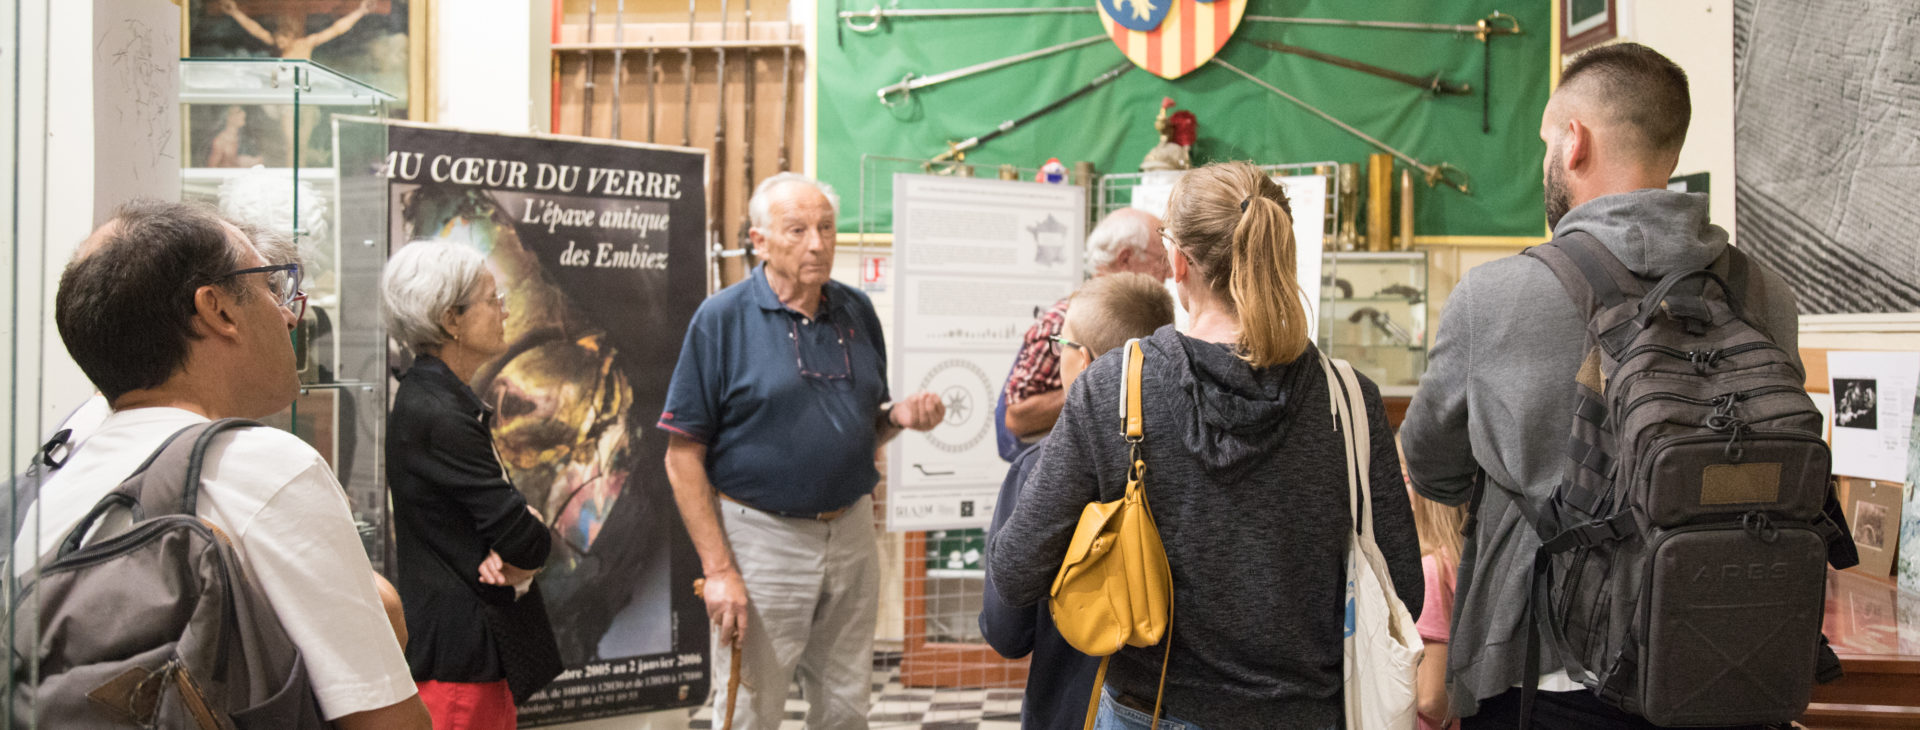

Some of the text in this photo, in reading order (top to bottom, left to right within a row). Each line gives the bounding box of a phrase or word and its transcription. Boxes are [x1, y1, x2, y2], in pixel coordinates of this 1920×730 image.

[377, 151, 681, 199] AU CŒUR DU VERRE
[522, 199, 670, 238] L'épave antique
[560, 241, 669, 270] des Embiez
[585, 663, 611, 678] 2005
[613, 664, 627, 674] au
[629, 660, 636, 673] 2
[638, 656, 675, 674] janvier
[678, 653, 703, 667] 2006
